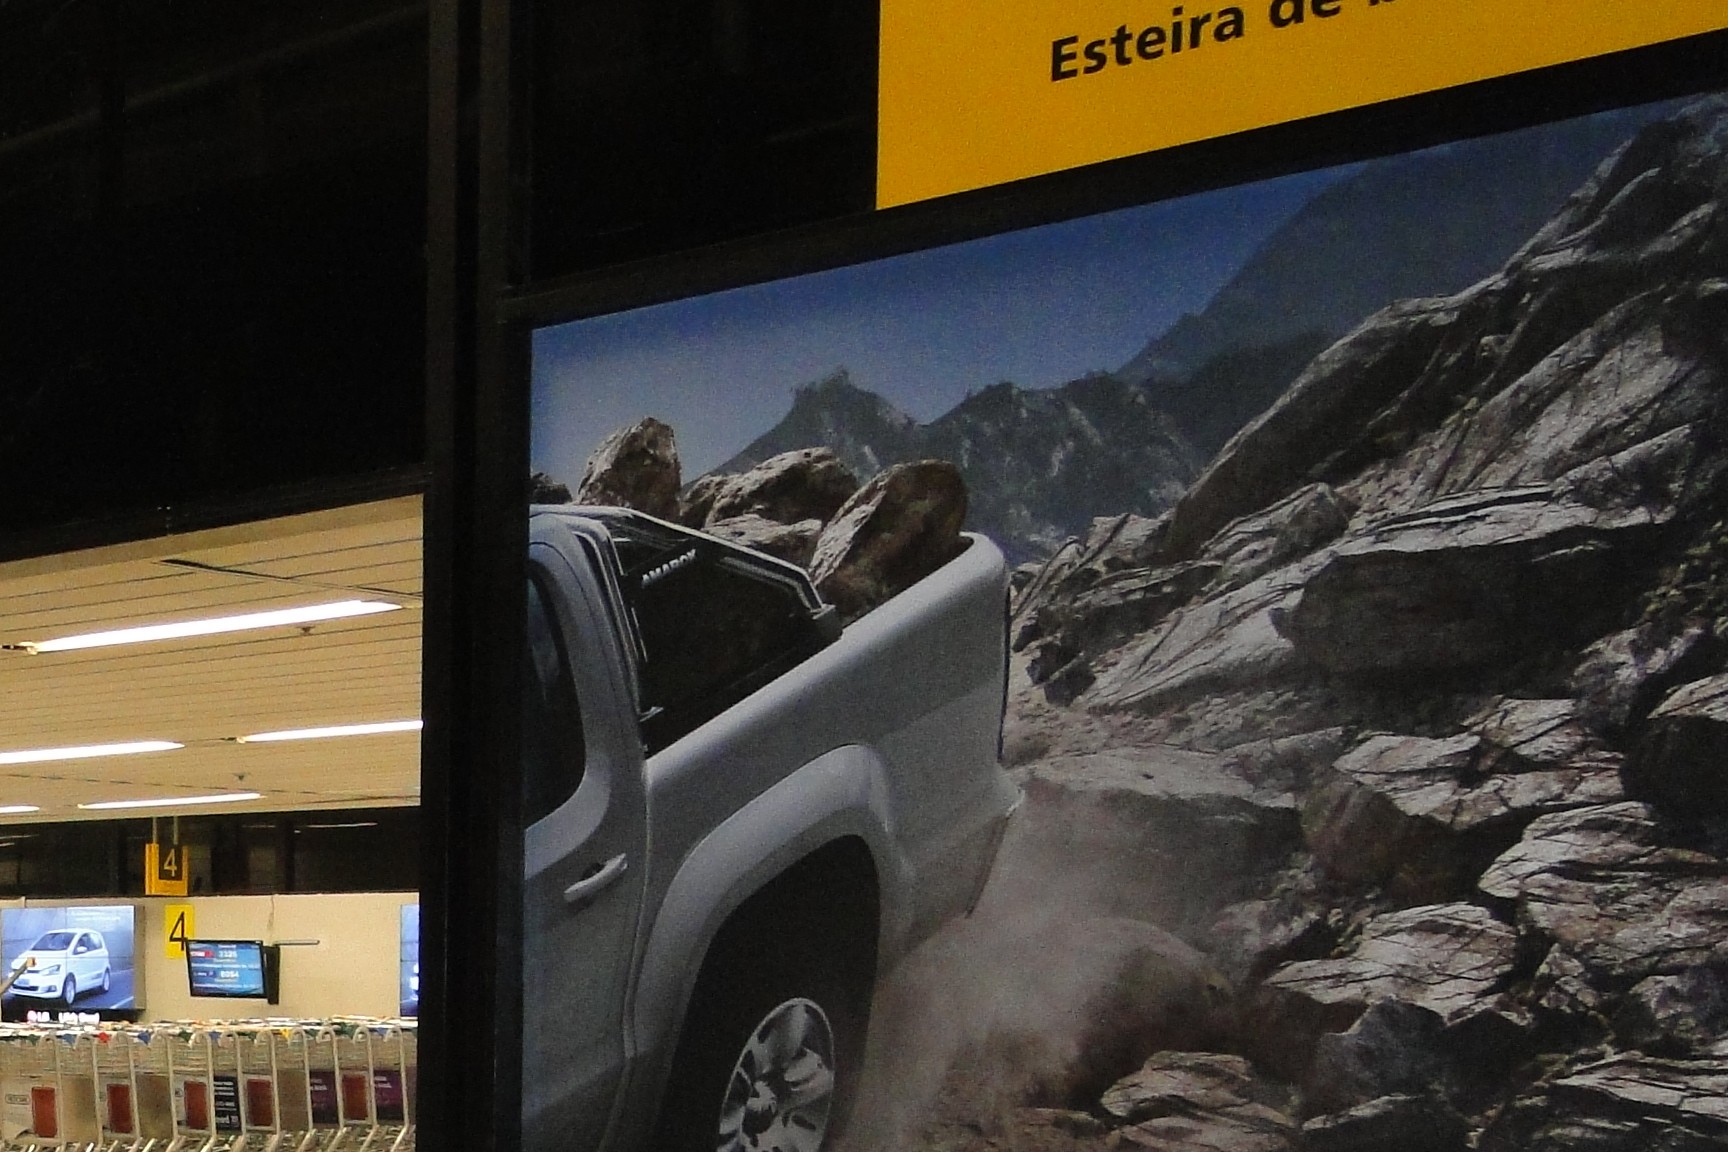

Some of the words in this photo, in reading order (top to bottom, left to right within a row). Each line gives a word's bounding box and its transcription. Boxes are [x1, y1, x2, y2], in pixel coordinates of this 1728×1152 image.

[1050, 6, 1245, 83] Esteira
[1268, 0, 1342, 29] de
[641, 548, 696, 588] AMAROK
[163, 848, 177, 877] 4
[169, 911, 188, 951] 4
